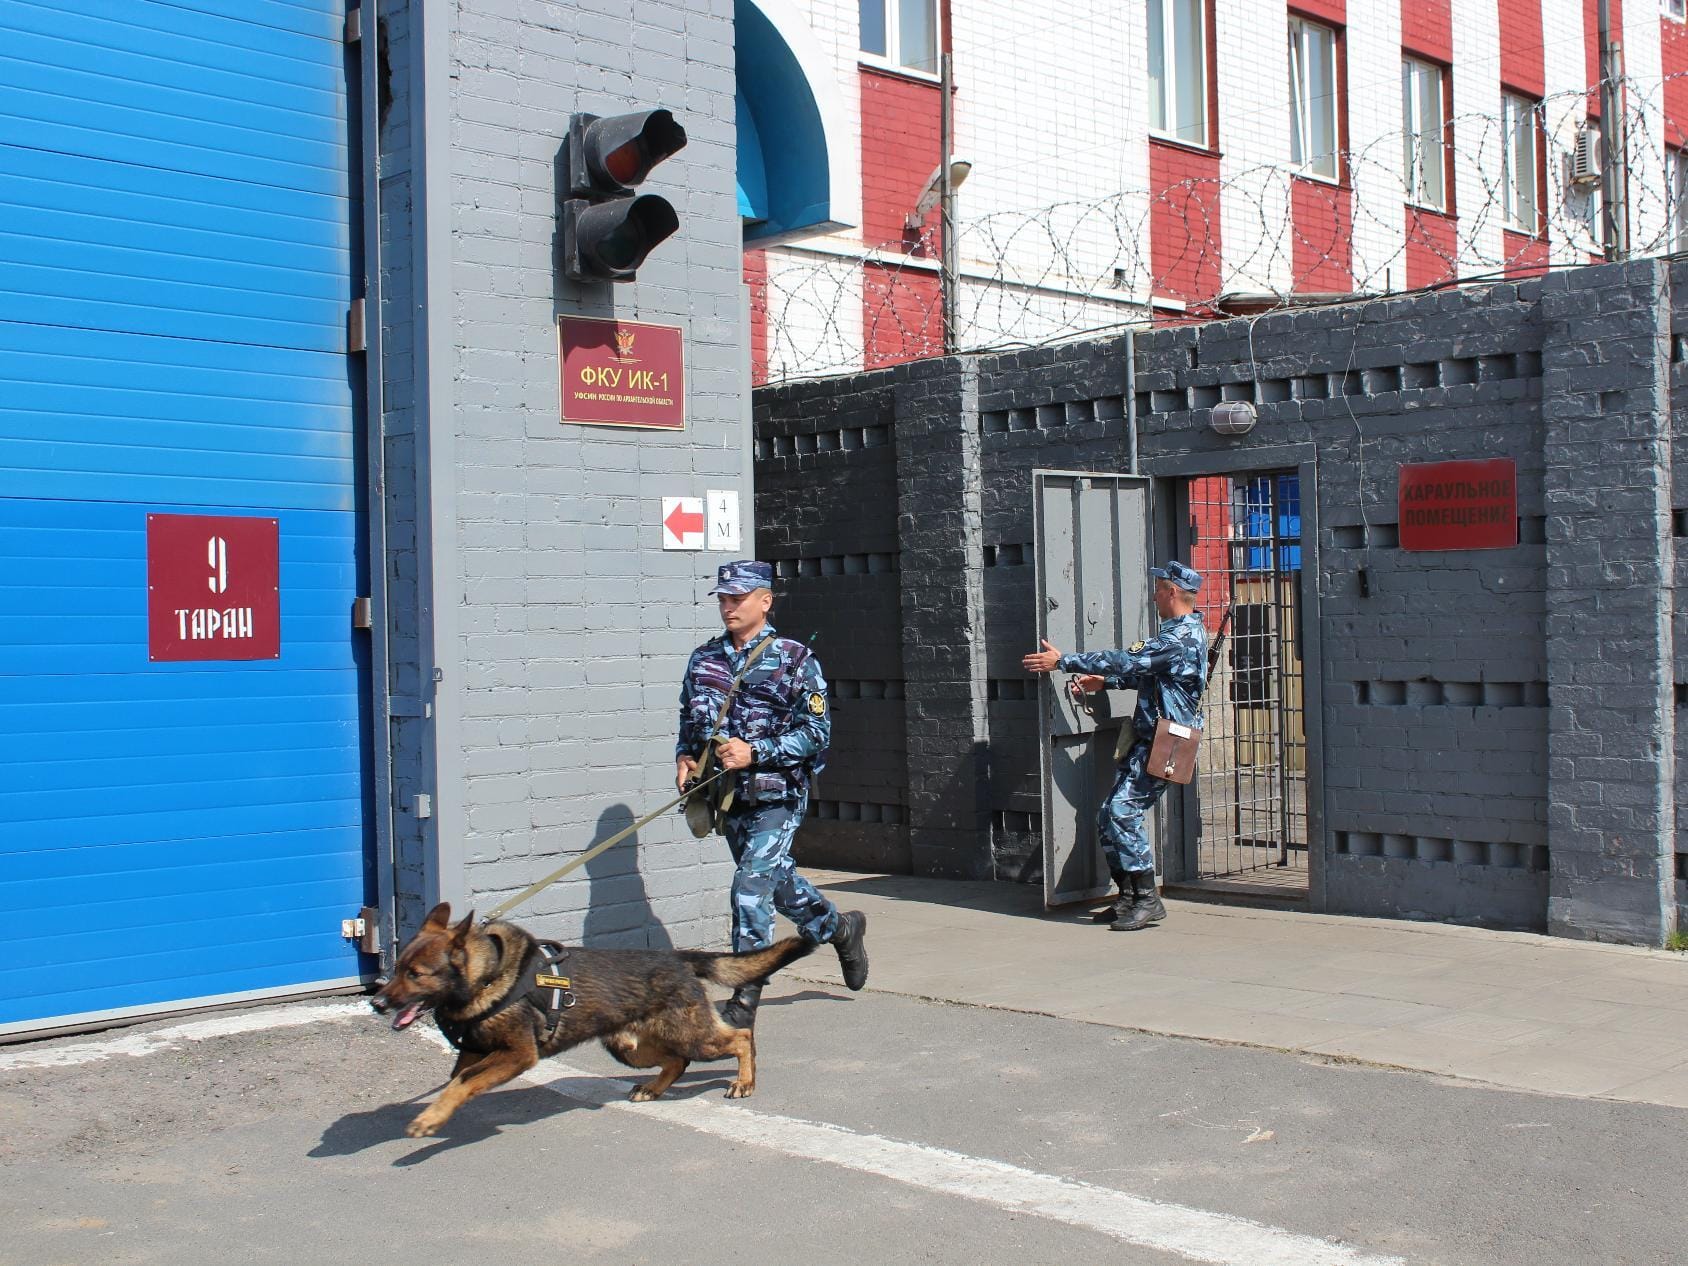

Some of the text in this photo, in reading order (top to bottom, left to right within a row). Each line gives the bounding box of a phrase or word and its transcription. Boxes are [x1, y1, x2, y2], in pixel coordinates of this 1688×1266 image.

[581, 366, 667, 391] ФКУ ИК-1
[574, 391, 597, 400] УФСИН
[1404, 480, 1510, 501] КАРАУЛЬНОЕ
[719, 499, 728, 513] 4
[1406, 505, 1510, 526] ПОМЕЩЕНИЕ
[718, 522, 731, 538] М
[208, 536, 227, 594] 9
[174, 607, 253, 640] ТАРАН
